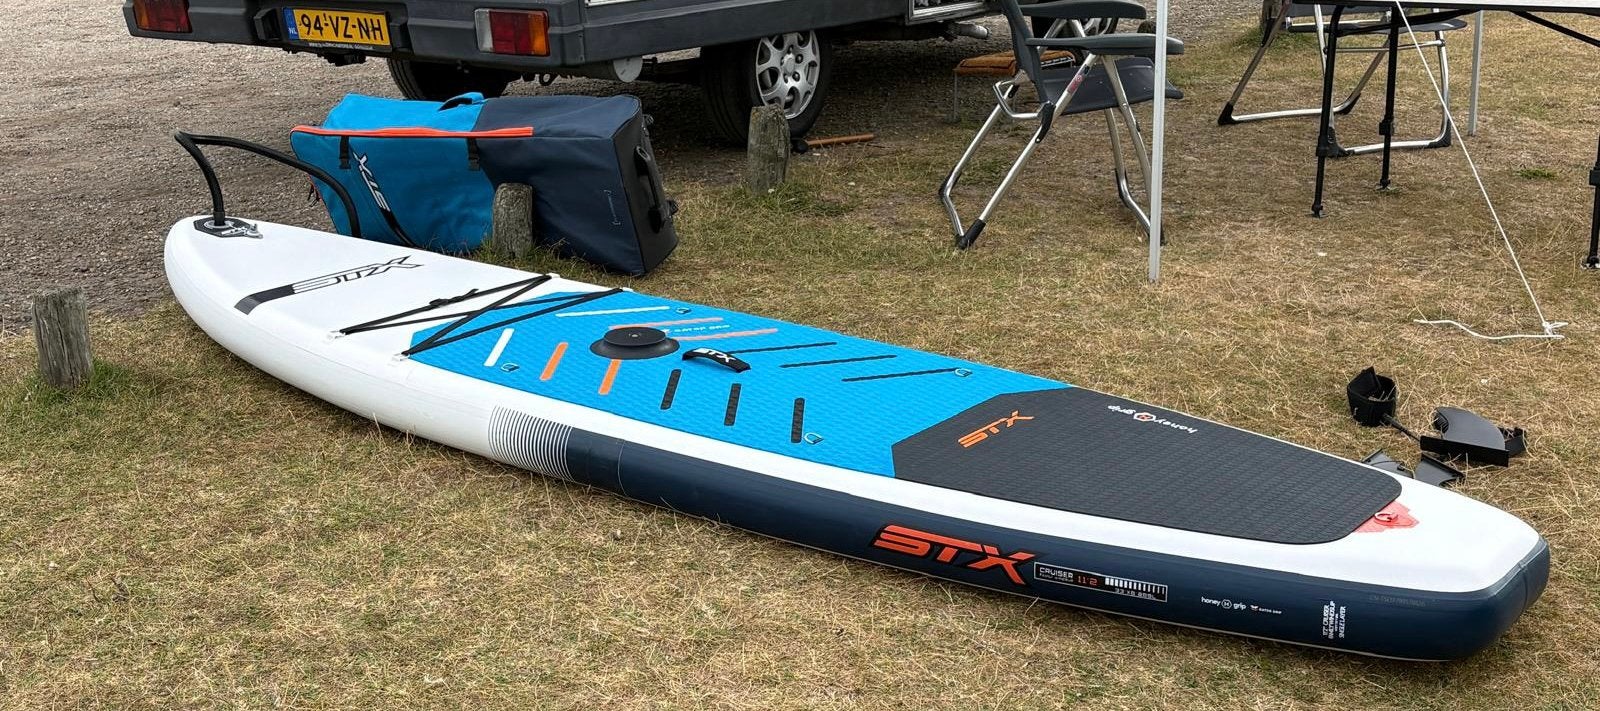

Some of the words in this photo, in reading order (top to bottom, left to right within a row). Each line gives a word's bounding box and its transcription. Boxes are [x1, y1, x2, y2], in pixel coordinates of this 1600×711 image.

[288, 27, 298, 35] NL
[352, 150, 392, 213] STX
[292, 255, 424, 294] STX
[692, 347, 737, 363] STX
[1107, 405, 1136, 415] grip
[957, 410, 1035, 449] STX
[1153, 418, 1198, 434] honey
[872, 524, 1038, 586] STX
[1039, 566, 1074, 579] CRUISER
[1201, 596, 1221, 607] honey
[1233, 602, 1247, 610] grip
